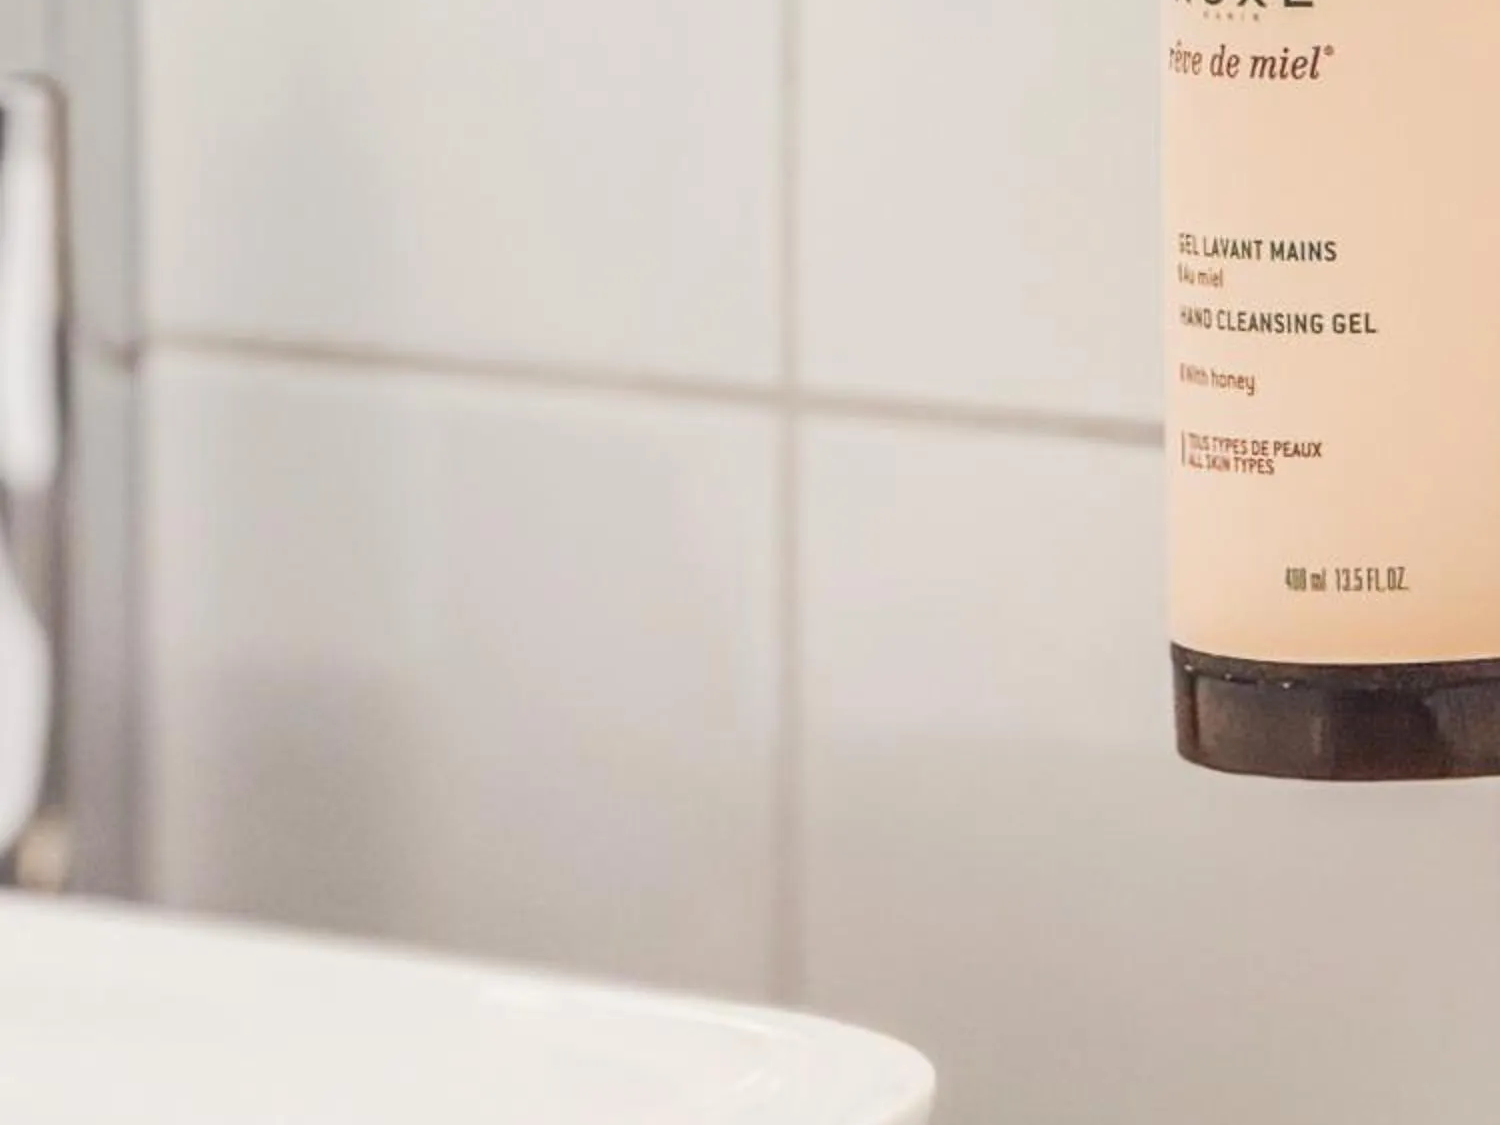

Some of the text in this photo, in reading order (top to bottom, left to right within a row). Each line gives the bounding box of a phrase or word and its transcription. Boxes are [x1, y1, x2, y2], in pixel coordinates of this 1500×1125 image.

[1168, 39, 1203, 76] rêve
[1210, 44, 1240, 79] de
[1203, 235, 1263, 261] LAVANT
[1270, 240, 1337, 263] MAINS
[1181, 306, 1377, 334] HAND CLEANSING GEL
[1211, 368, 1255, 396] honey
[1212, 436, 1248, 456] TYPES
[1251, 439, 1269, 456] DE
[1273, 441, 1322, 458] PEAUX
[1233, 457, 1275, 475] TYPES
[1335, 567, 1364, 592] 13.5
